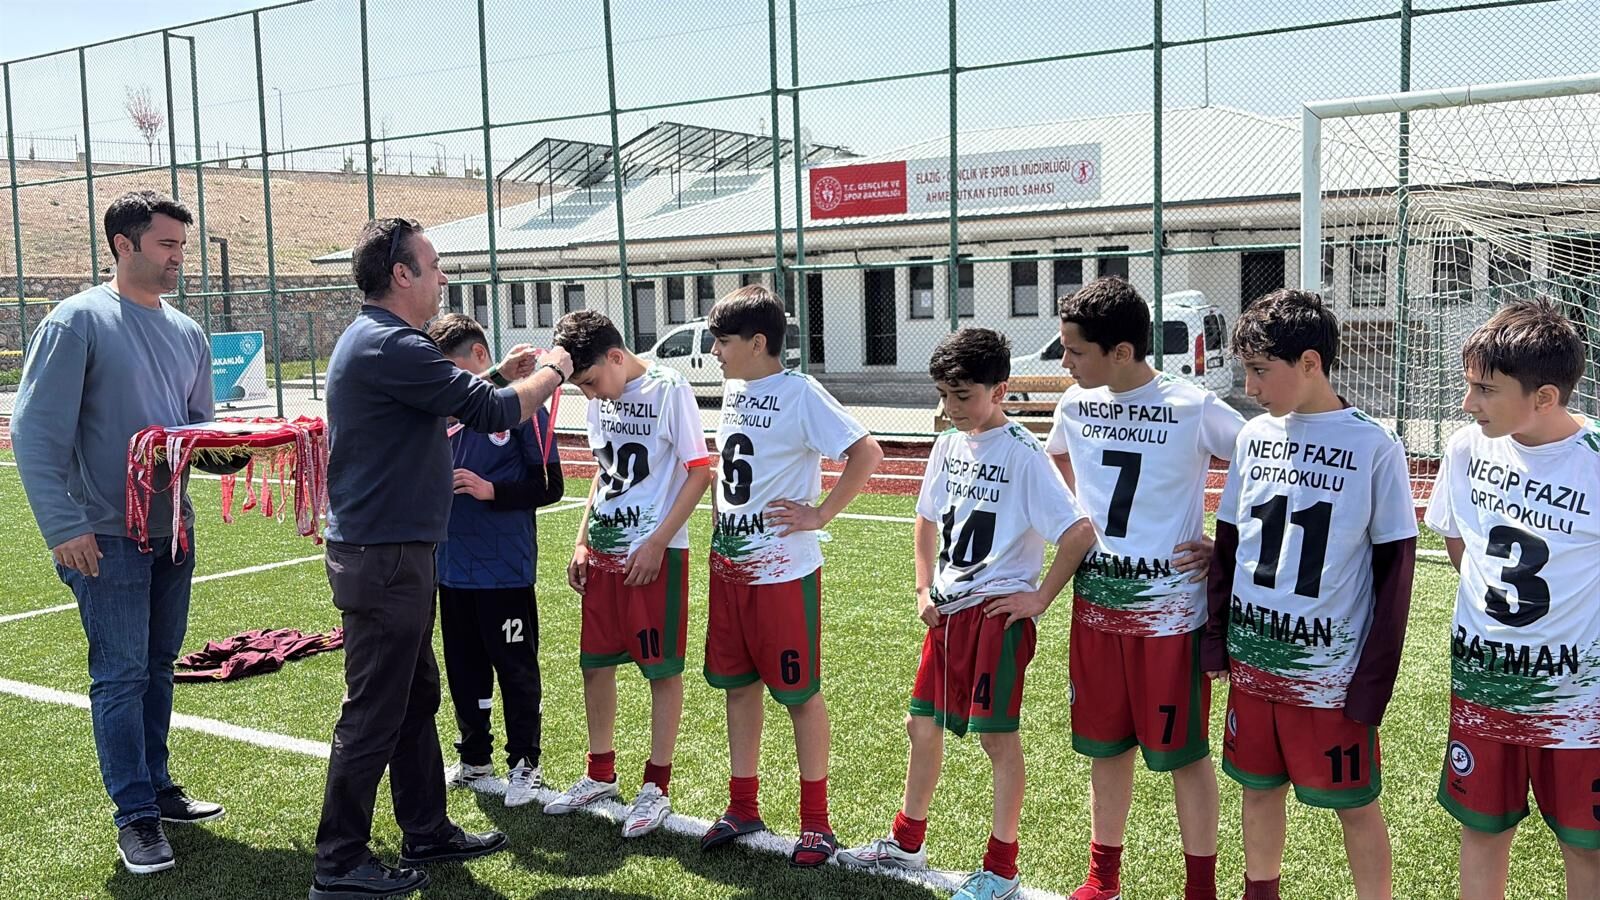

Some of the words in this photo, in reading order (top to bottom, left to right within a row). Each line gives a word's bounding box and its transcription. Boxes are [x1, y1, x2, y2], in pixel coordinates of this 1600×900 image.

[857, 180, 889, 191] GENÇLİK
[890, 180, 900, 188] VE
[979, 167, 989, 179] VE
[991, 165, 1010, 179] SPOR
[843, 192, 862, 201] SPOR
[863, 190, 901, 200] BAKANLIĞI
[926, 191, 950, 203] AHME
[987, 184, 1020, 198] FUTBOL
[1022, 182, 1055, 196] SAHASI
[623, 402, 657, 418] FAZIL
[723, 413, 771, 429] RTAOKULU
[1078, 400, 1123, 421] NECİP
[1128, 405, 1179, 424] FAZIL
[600, 418, 651, 436] RTAOKULU
[1081, 423, 1168, 445] ORTAOKULU
[722, 433, 754, 506] 6
[1247, 437, 1300, 460] NECİP
[1303, 443, 1358, 471] FAZIL
[1101, 449, 1142, 539] 7
[1250, 465, 1345, 493] ORTAOKULU
[1466, 456, 1520, 492] NECİP
[1524, 478, 1591, 516] FAZIL
[1471, 488, 1573, 535] ORTAOKULU
[1250, 494, 1333, 599] 11
[1484, 524, 1551, 628] 3
[502, 618, 524, 643] 12
[1232, 594, 1332, 647] BATMAN
[636, 627, 660, 659] 10
[1454, 624, 1579, 678] BATMAN
[780, 650, 801, 685] 6
[1159, 705, 1177, 744] 7
[1325, 743, 1361, 783] 11
[802, 831, 824, 849] UP
